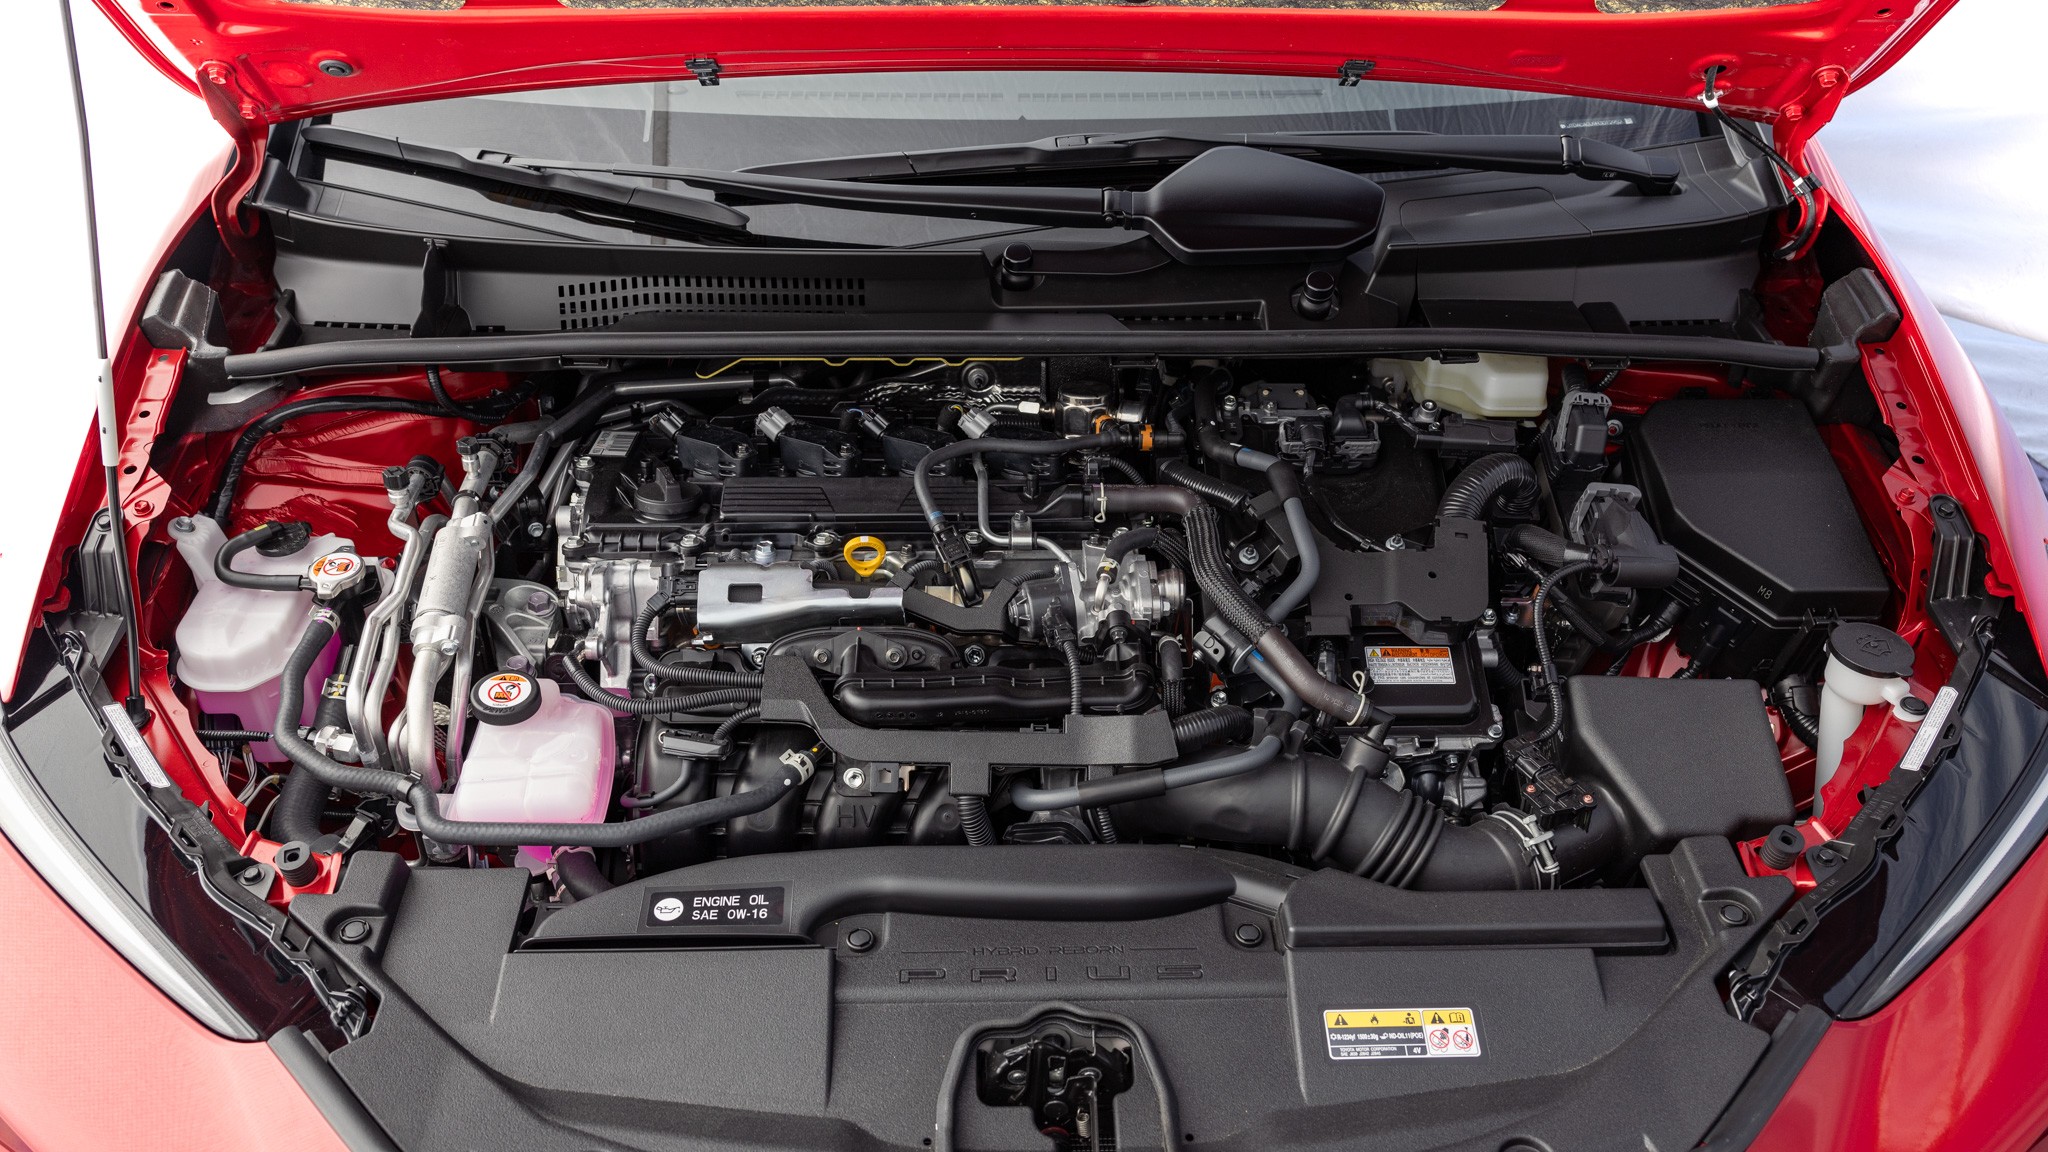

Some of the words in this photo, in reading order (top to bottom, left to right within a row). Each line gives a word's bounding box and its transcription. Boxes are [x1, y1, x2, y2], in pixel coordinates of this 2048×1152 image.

[1757, 585, 1773, 599] M8
[1203, 636, 1216, 649] D
[836, 804, 877, 828] HV
[693, 895, 741, 907] ENGINE
[749, 894, 769, 905] OIL
[691, 909, 719, 920] SAE
[972, 946, 1040, 956] HYBRID
[1050, 944, 1125, 955] REBORN
[899, 963, 1204, 984] PRIUS
